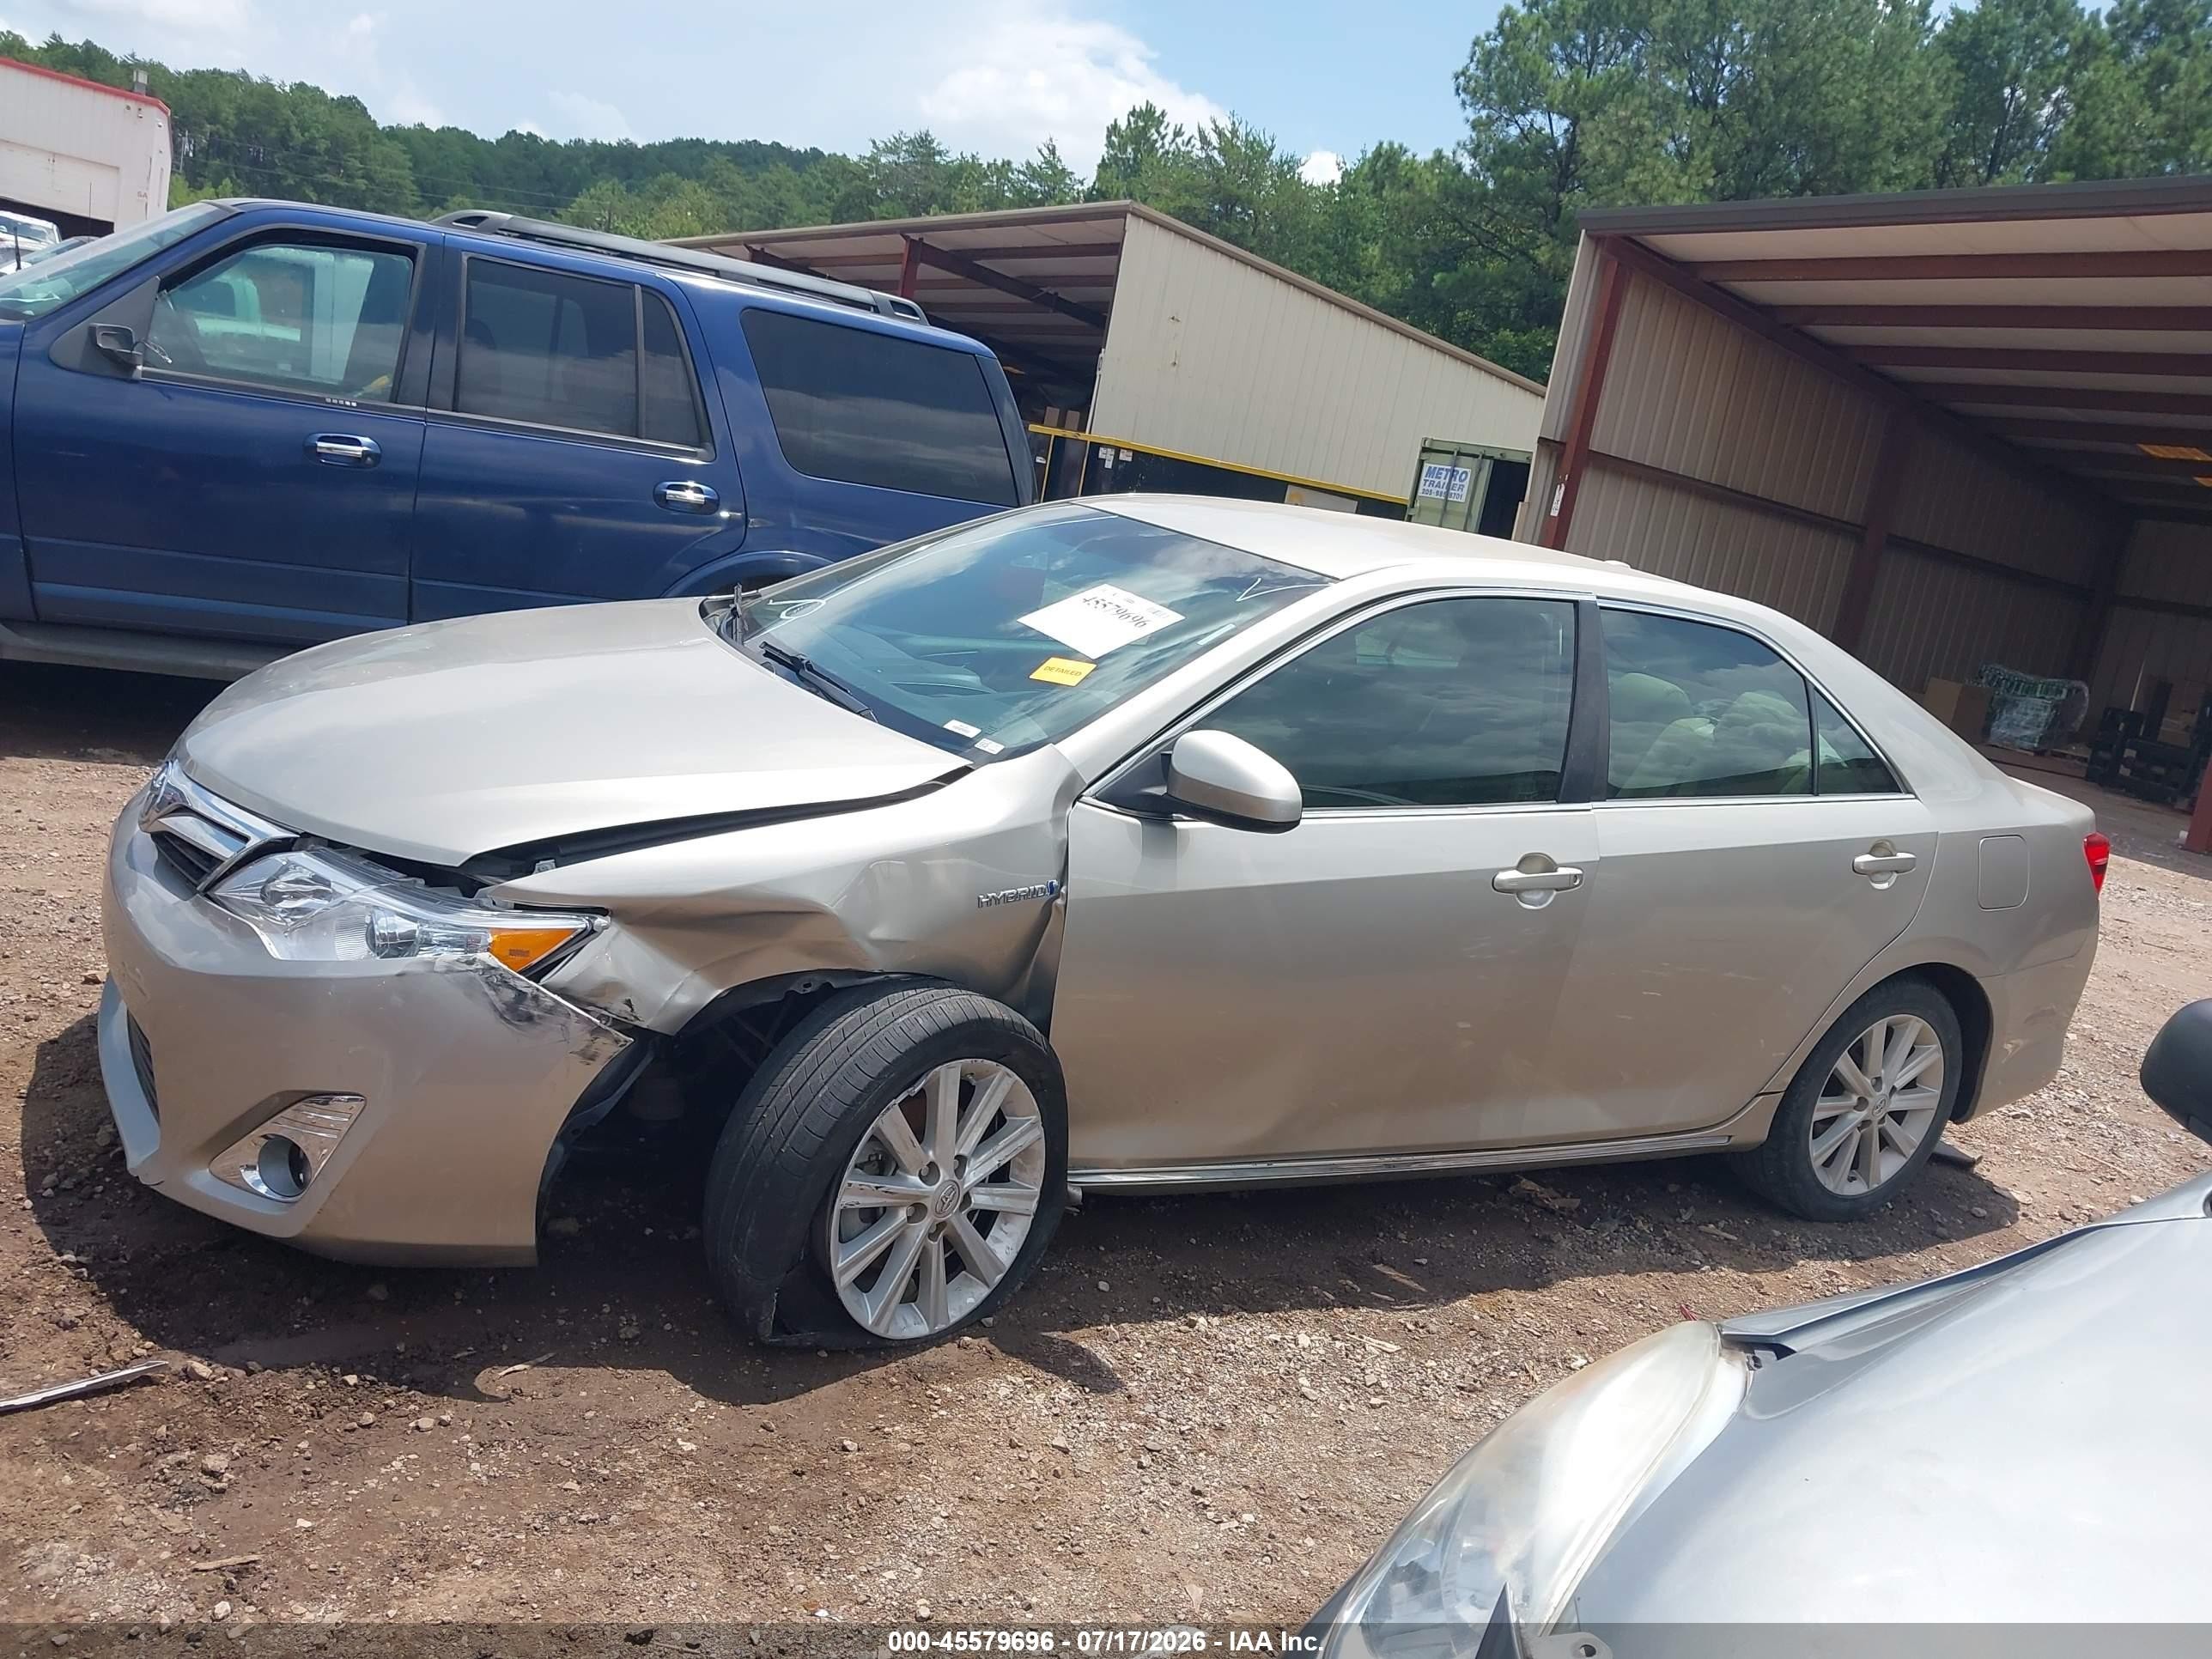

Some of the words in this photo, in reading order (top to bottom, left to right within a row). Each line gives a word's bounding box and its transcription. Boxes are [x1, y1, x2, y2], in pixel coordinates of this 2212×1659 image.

[1425, 465, 1469, 483] METRO
[1043, 665, 1083, 677] DETAILED
[977, 884, 1046, 908] HYBRID
